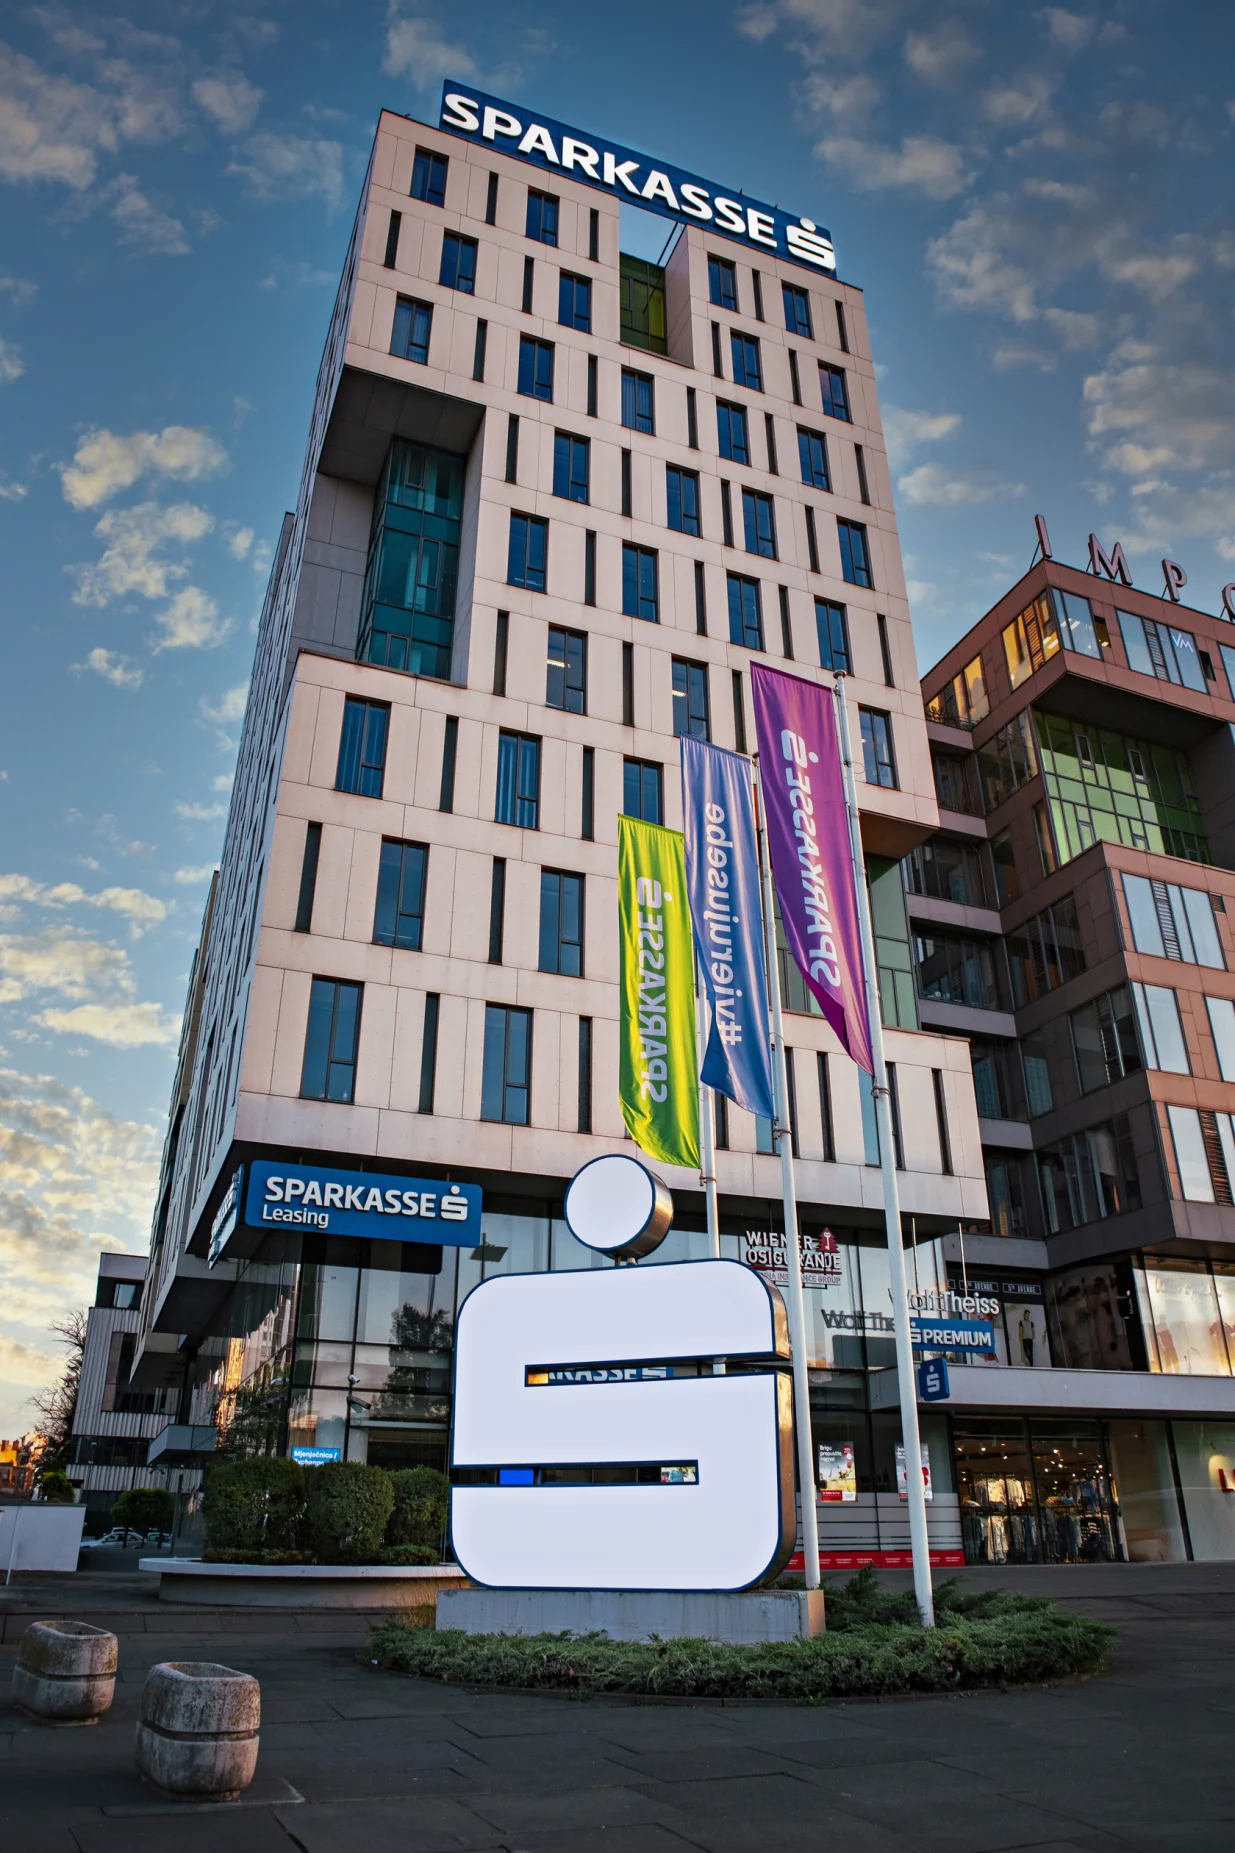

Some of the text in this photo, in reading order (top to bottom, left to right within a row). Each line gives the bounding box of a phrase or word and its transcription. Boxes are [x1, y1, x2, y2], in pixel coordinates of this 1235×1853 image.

[442, 93, 778, 249] SPARKASSE
[265, 1176, 437, 1218] SPARKASSE
[262, 1204, 329, 1229] Leasing
[940, 1290, 1000, 1315] Theiss
[922, 1328, 992, 1347] PREMIUM
[1217, 1468, 1235, 1493] L
